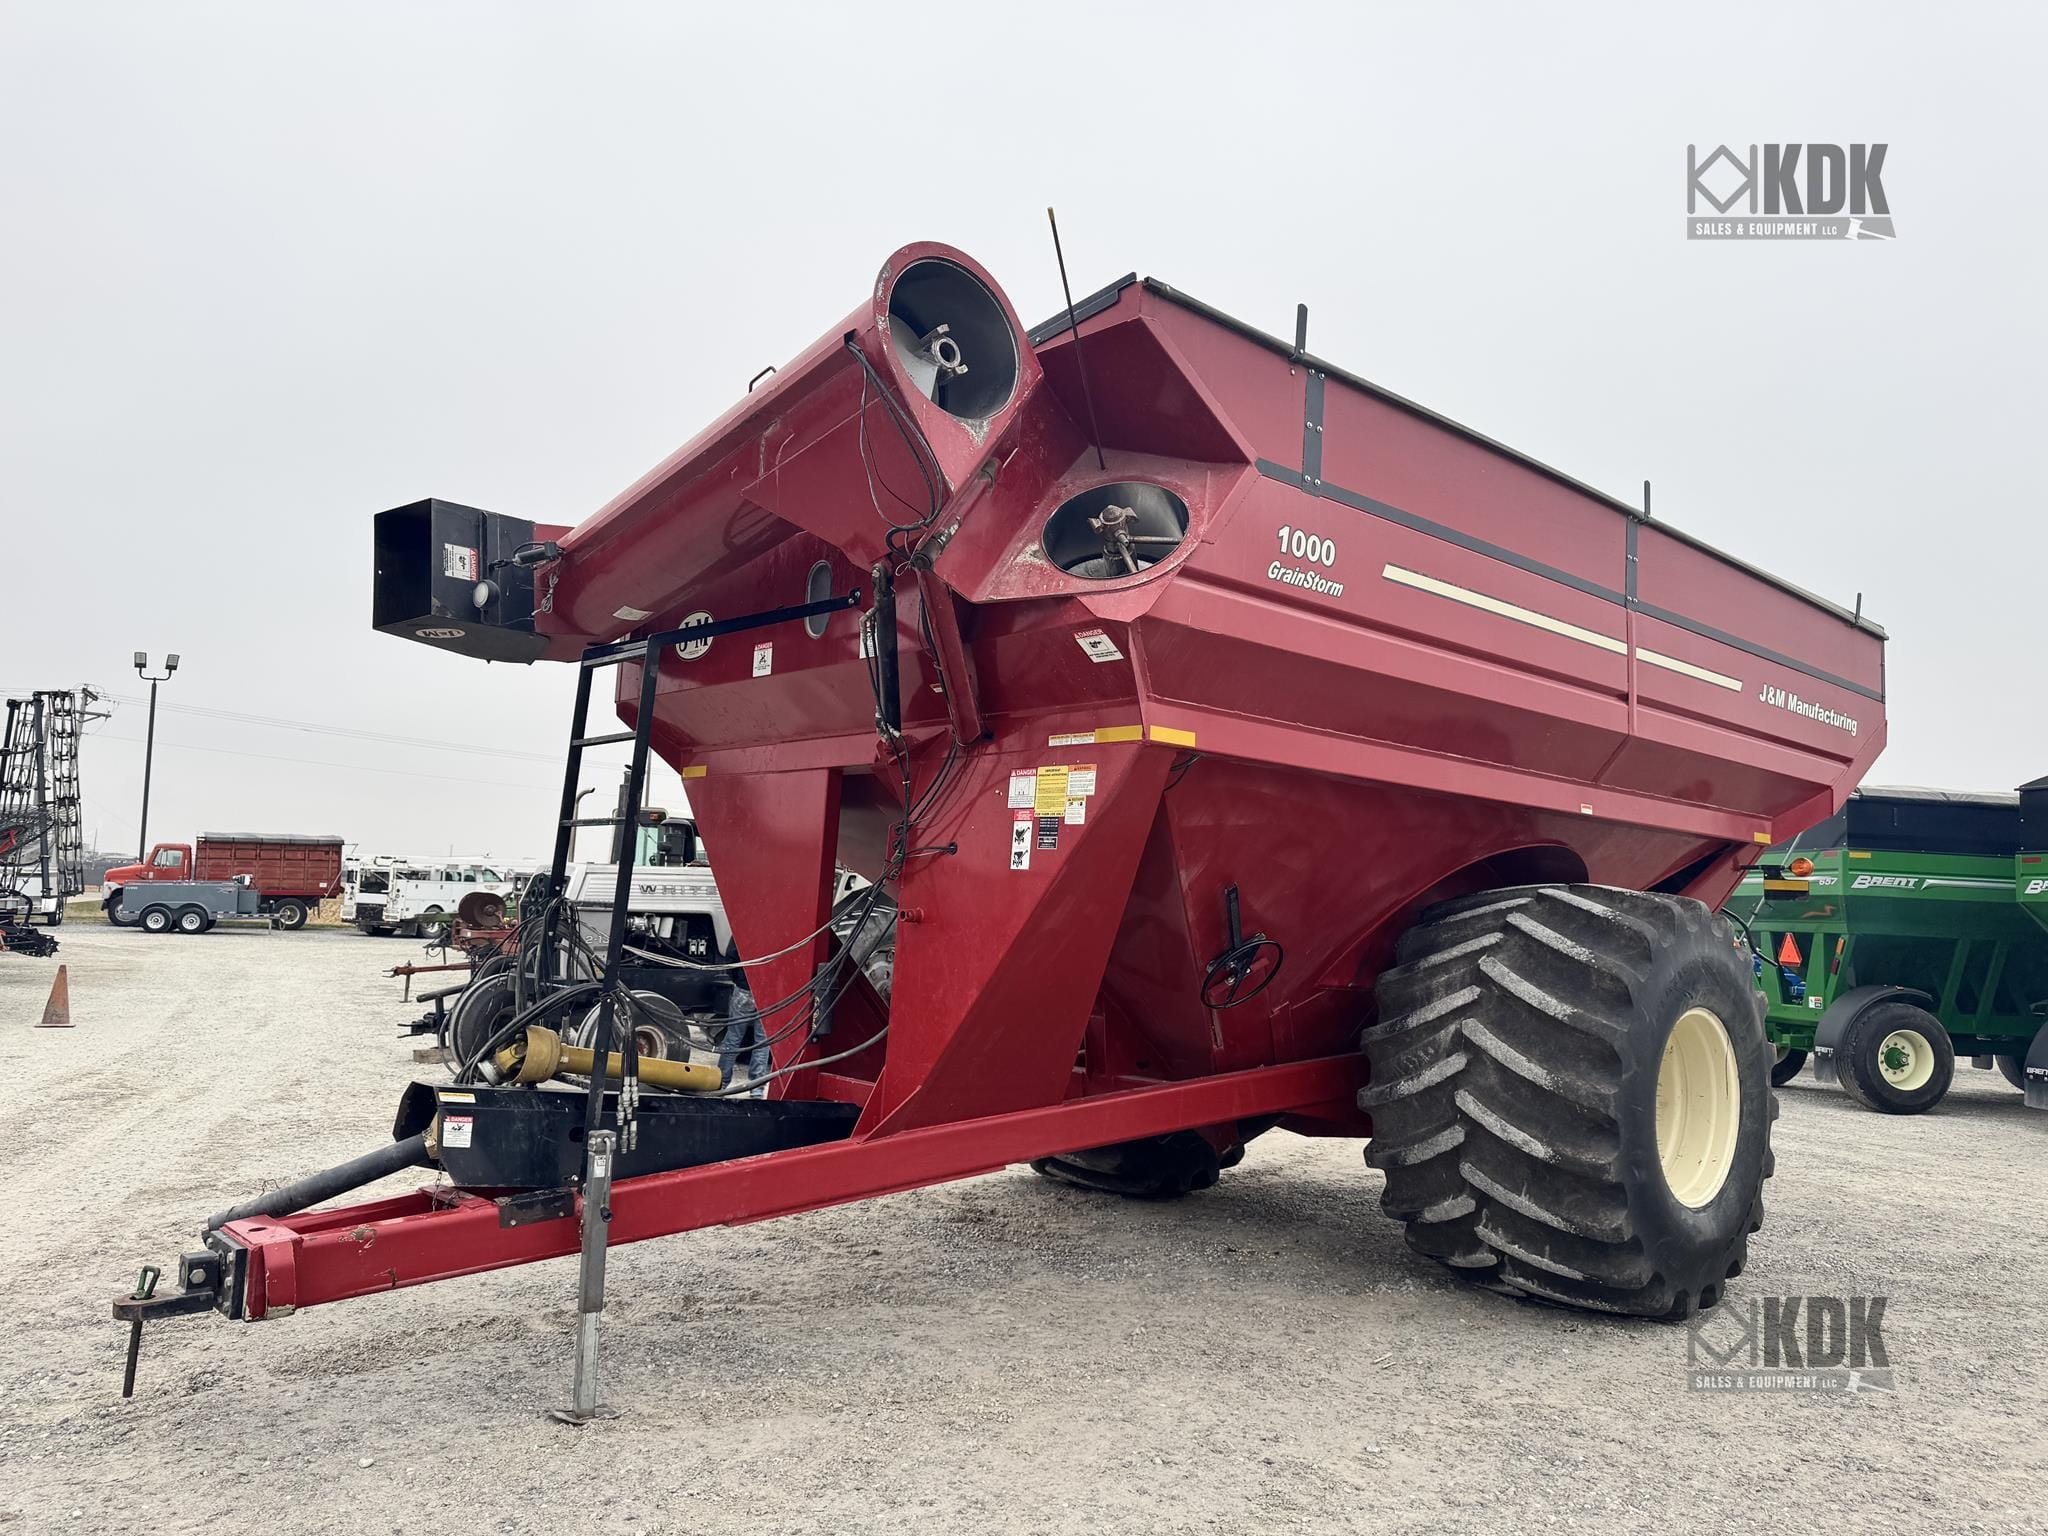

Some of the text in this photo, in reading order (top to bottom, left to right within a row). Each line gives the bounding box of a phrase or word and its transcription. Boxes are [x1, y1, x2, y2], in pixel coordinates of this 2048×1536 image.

[1277, 524, 1336, 568] 1000
[1267, 560, 1344, 598] GrainStorm
[1759, 684, 1858, 738] J&M Manufacturing
[1851, 875, 1919, 889] BRENT
